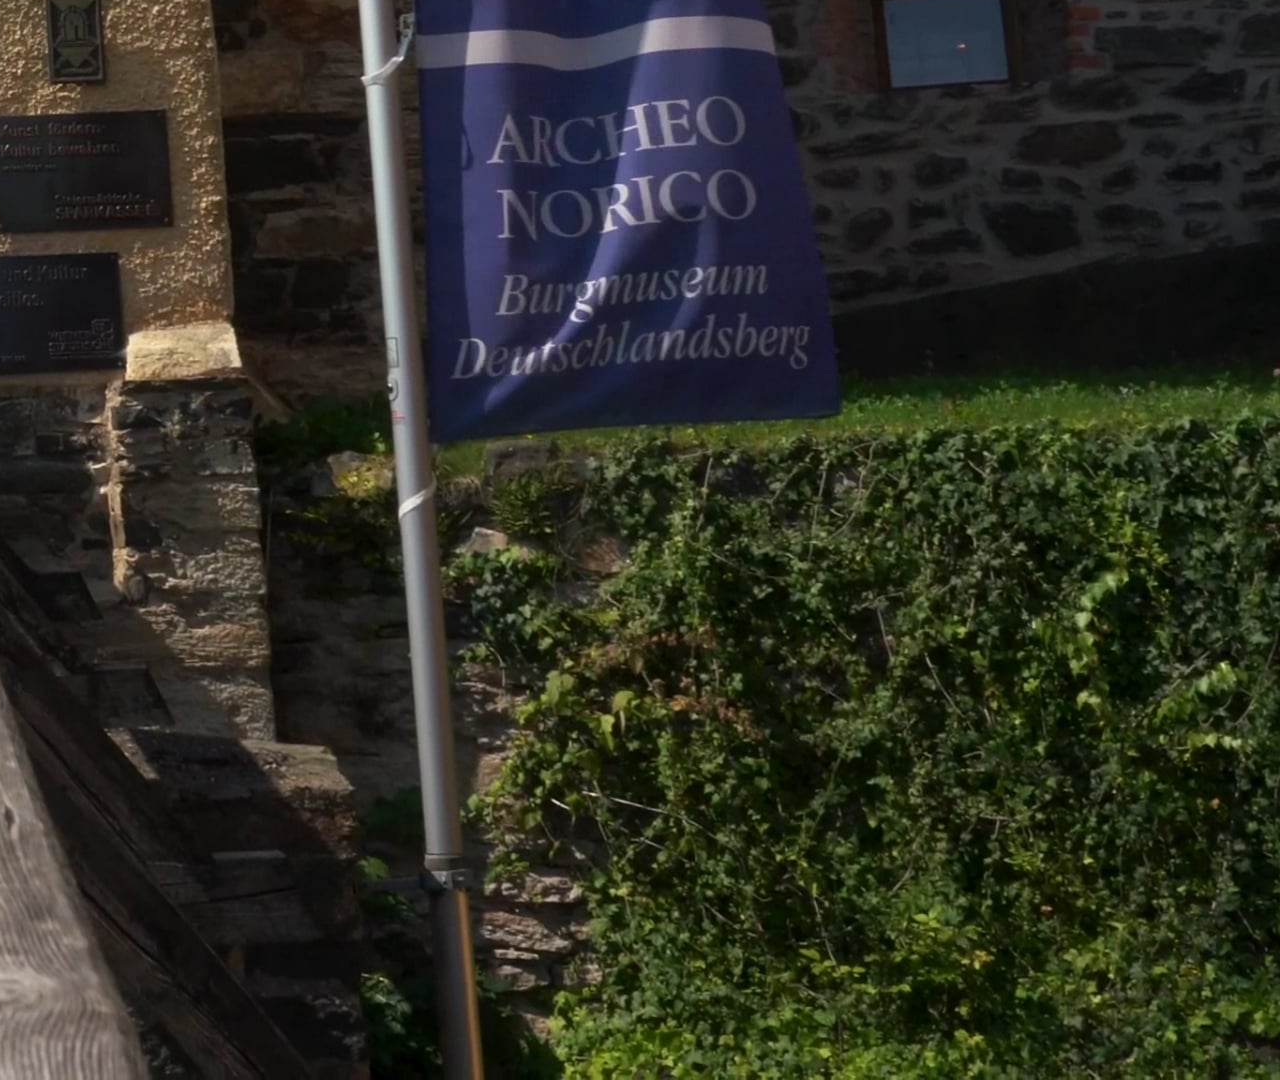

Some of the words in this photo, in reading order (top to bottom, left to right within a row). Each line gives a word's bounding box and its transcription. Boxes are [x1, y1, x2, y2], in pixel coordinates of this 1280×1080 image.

[486, 96, 746, 168] ARCHEO
[497, 169, 757, 240] NORICO
[495, 264, 768, 323] Burgmuseum
[451, 313, 810, 379] Deutschlandsberg
